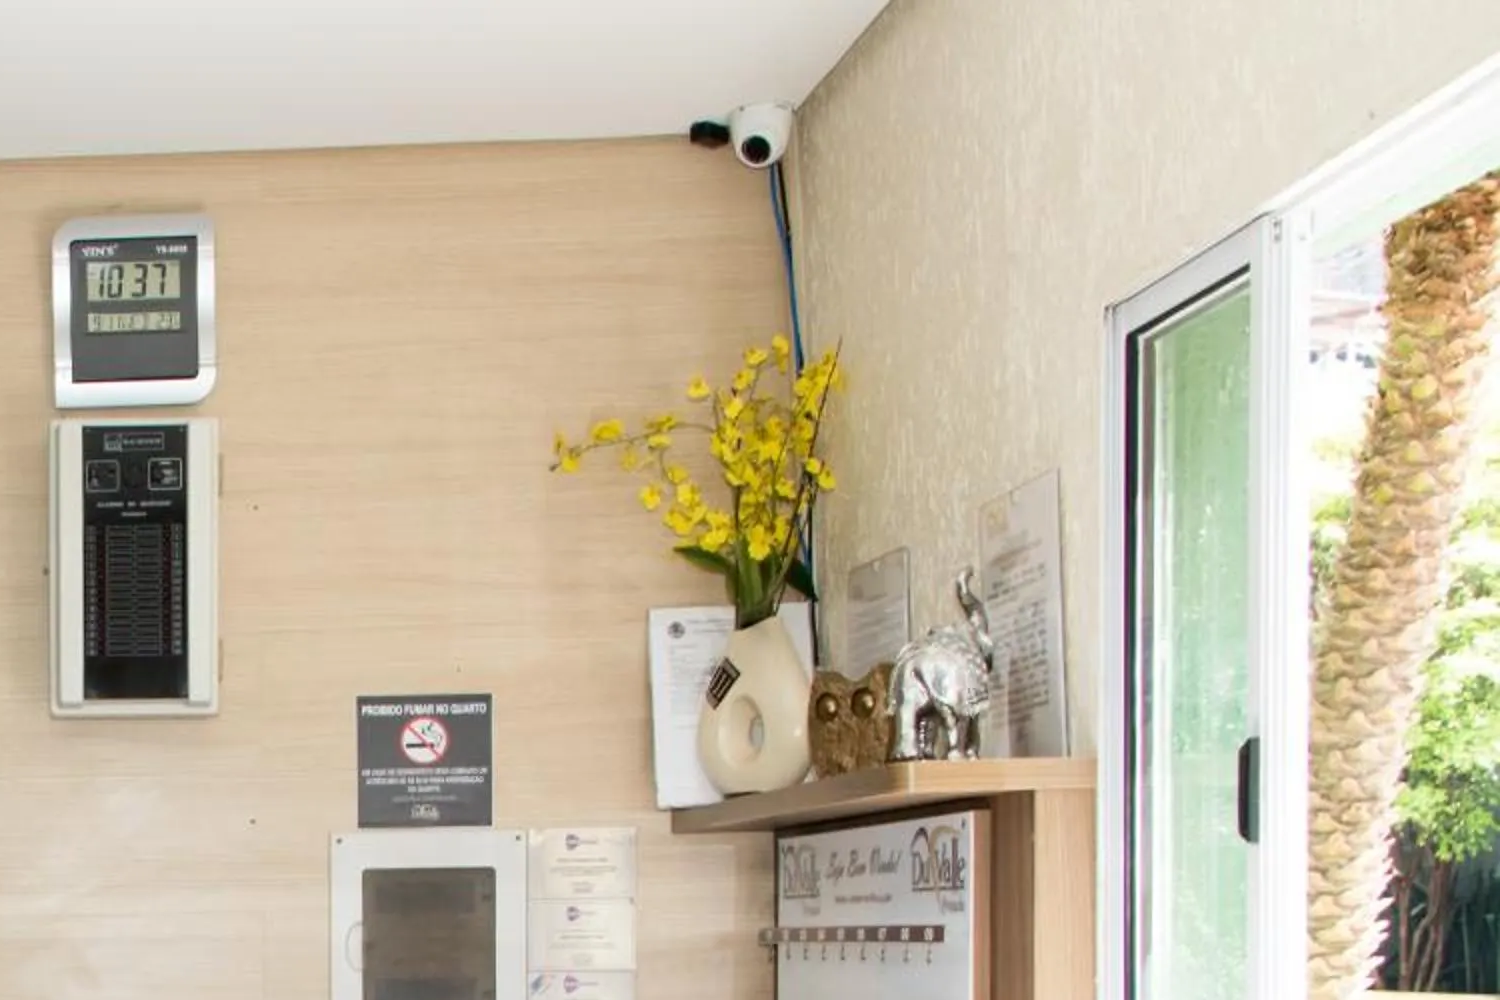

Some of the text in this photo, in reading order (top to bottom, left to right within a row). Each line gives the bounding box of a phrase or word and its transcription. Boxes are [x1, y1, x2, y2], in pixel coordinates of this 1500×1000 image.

[361, 702, 488, 716] PROIBIDO FUMAR NO QUARTO
